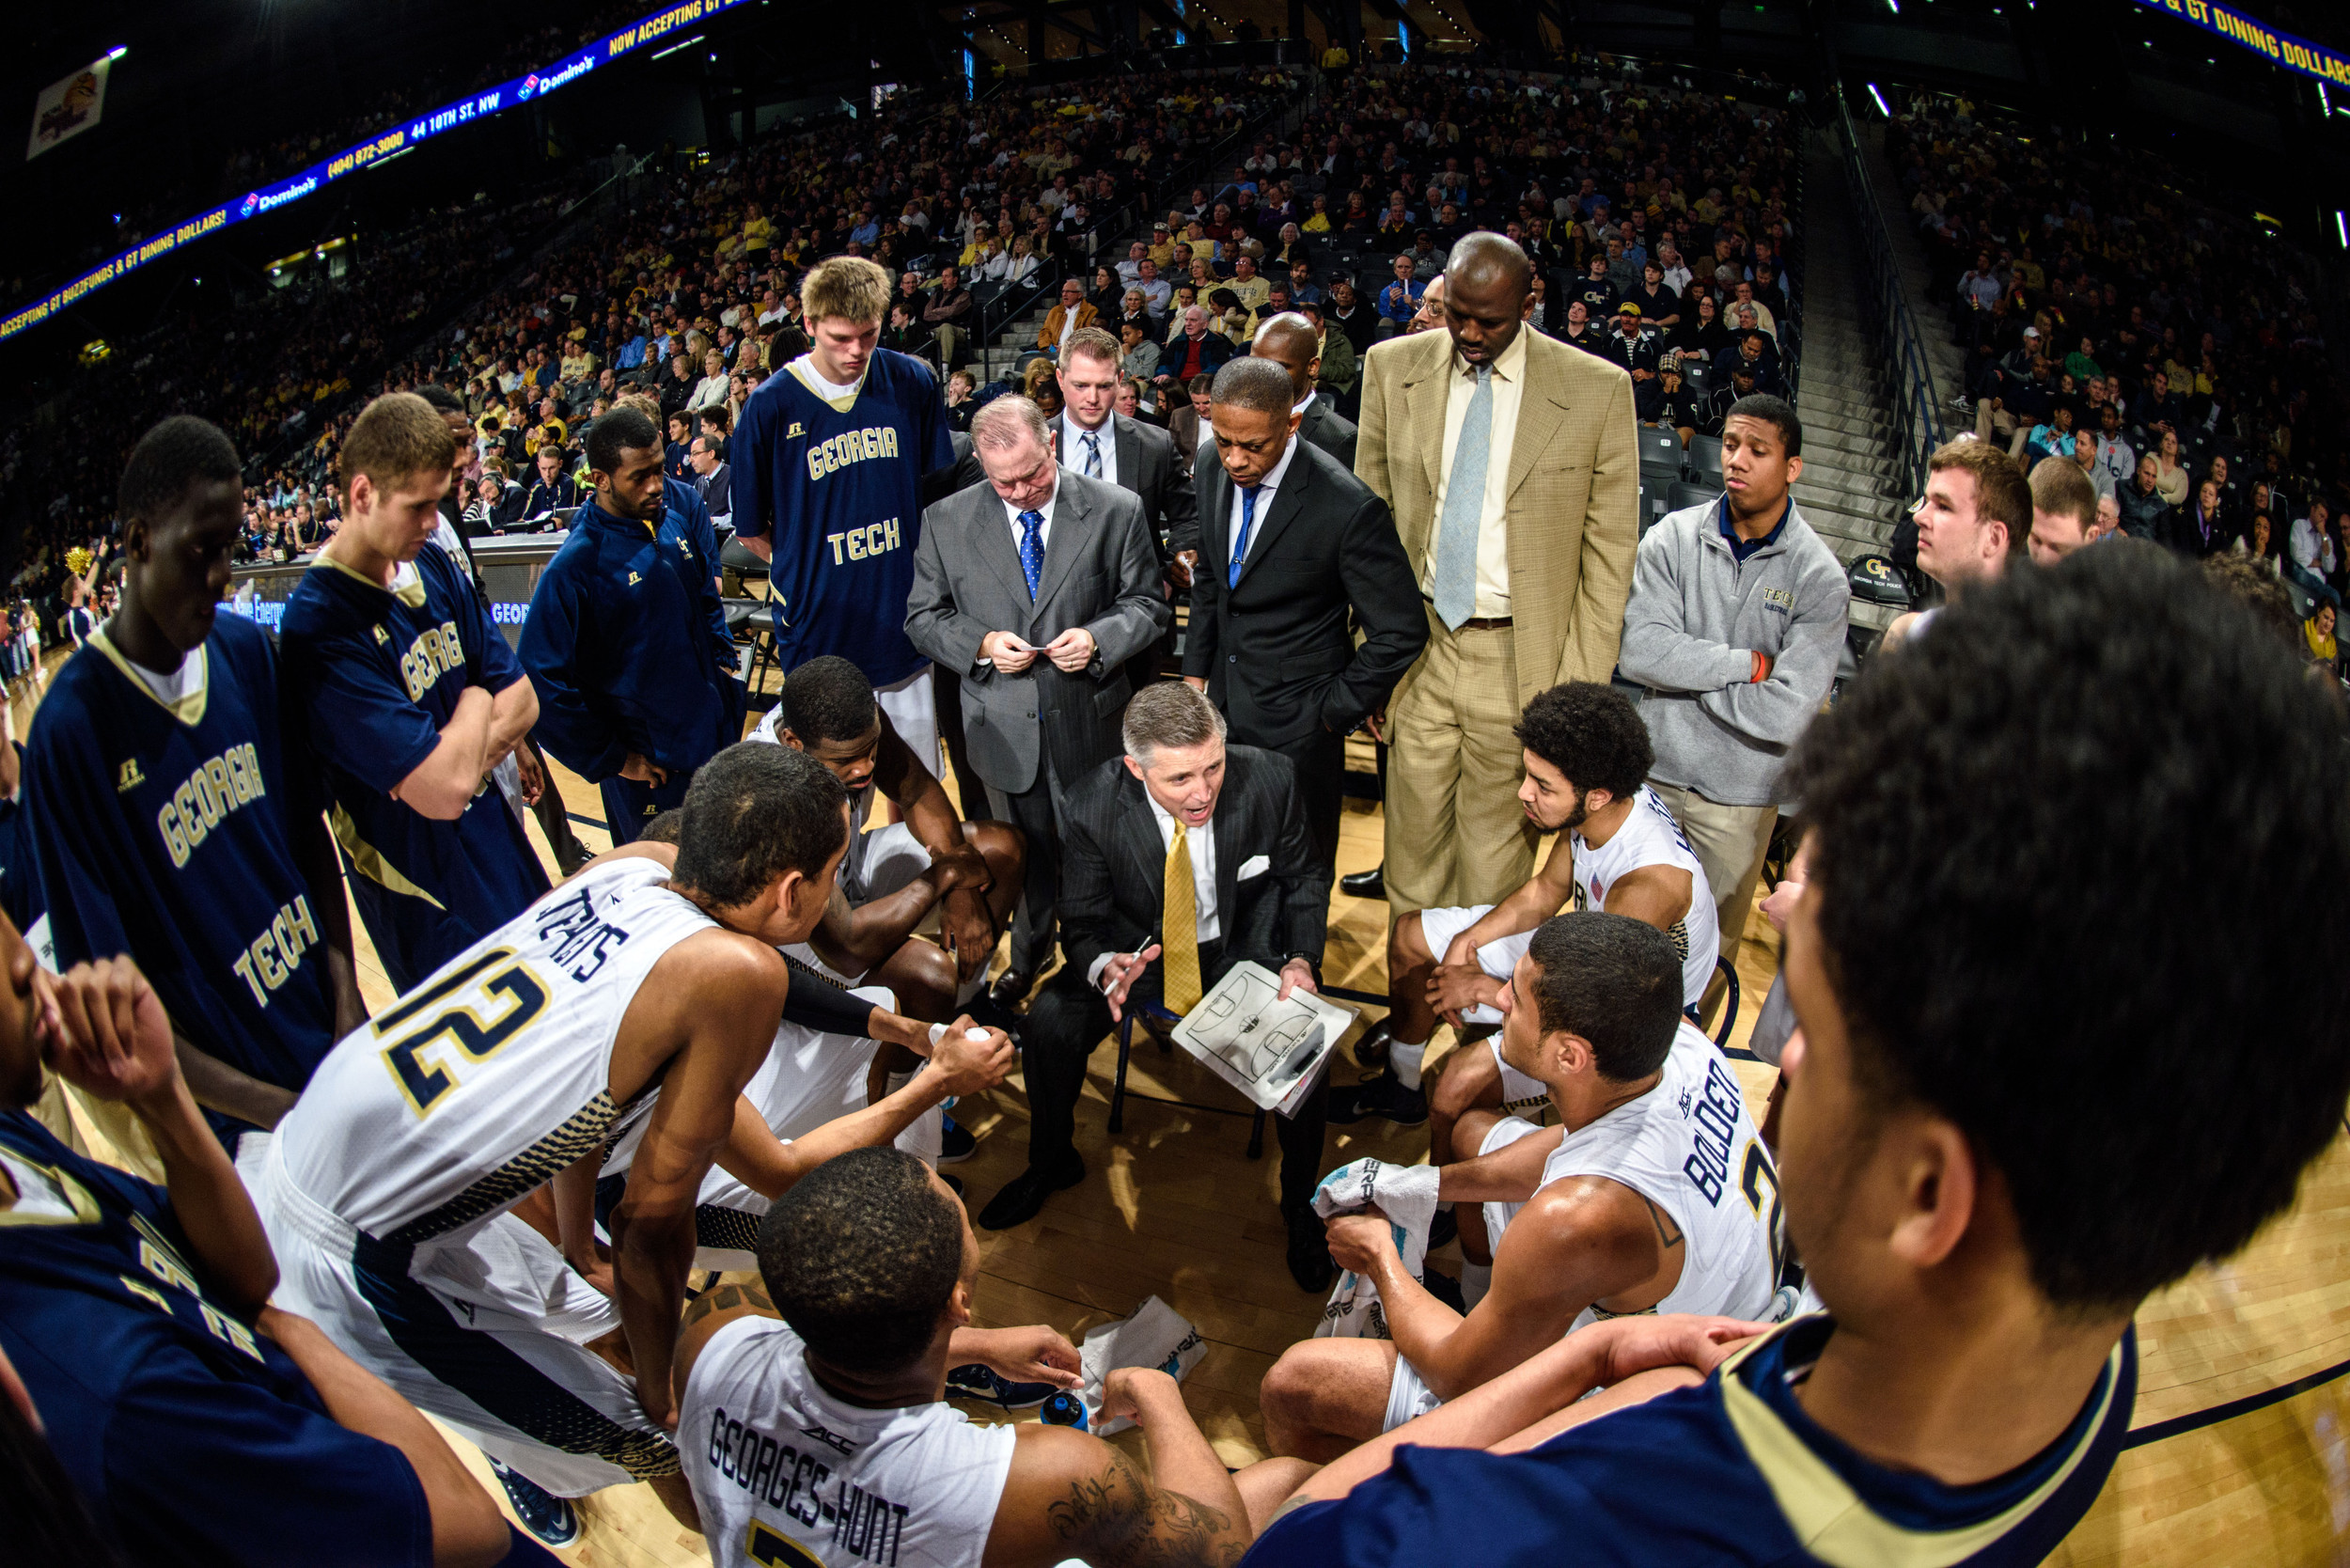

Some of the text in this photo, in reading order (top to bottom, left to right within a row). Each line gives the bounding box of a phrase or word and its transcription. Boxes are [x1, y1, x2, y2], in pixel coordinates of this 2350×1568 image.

[608, 30, 636, 56] NOW
[637, 1, 702, 43] ACCEPTING
[2186, 0, 2210, 24] GT
[2213, 7, 2280, 58] DINING
[539, 55, 596, 94] Domino's
[411, 92, 501, 140] 44 10TH ST. NW
[327, 130, 405, 180] (404) 872-3000
[258, 176, 318, 211] Domino's
[0, 209, 227, 337] ACCEPTING GT BUZZFUNDS & GT DINING DOLLARS!
[807, 427, 899, 481] GEORGIA
[827, 517, 901, 566] TECH
[1854, 575, 1872, 585] GEORGIA
[1866, 558, 1891, 580] GT
[157, 742, 266, 869] GEORGIA
[232, 894, 319, 1009] TECH
[369, 944, 554, 1122] 12
[1678, 1086, 1693, 1121] ACC
[1683, 1058, 1740, 1210] BOLDEN
[799, 1425, 859, 1456] ACC
[708, 1406, 910, 1568] GEORGES-HUNT
